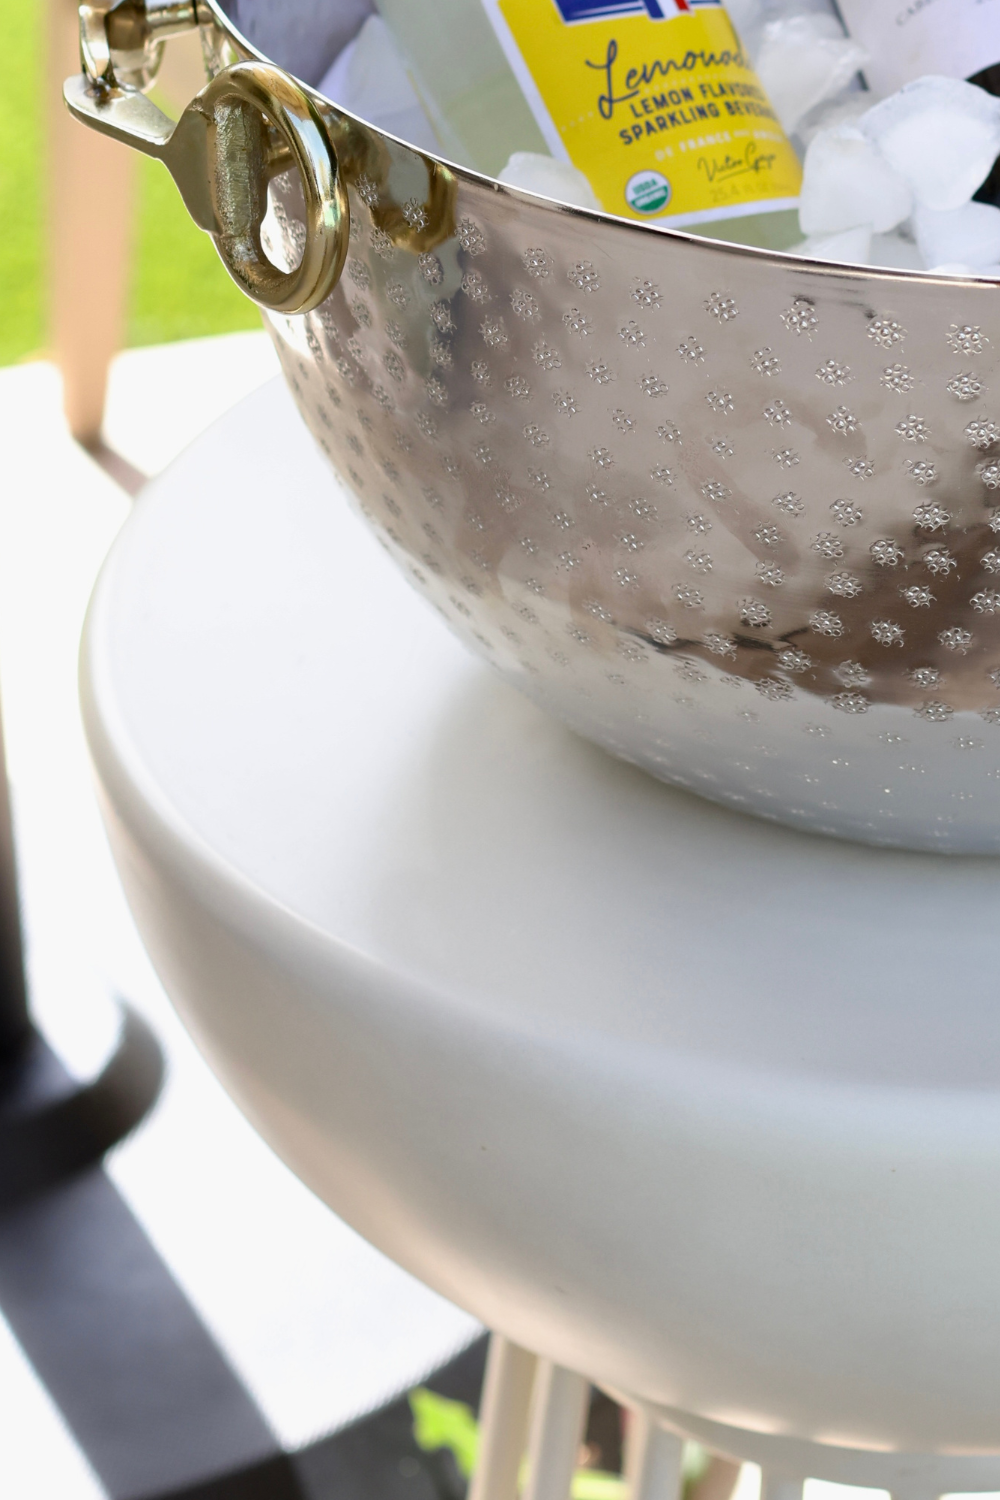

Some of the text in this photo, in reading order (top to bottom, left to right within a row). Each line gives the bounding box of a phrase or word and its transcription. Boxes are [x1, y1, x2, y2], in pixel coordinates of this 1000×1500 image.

[585, 30, 753, 119] Lemonad
[619, 102, 721, 146] SPARKLING
[630, 87, 695, 119] LEMON
